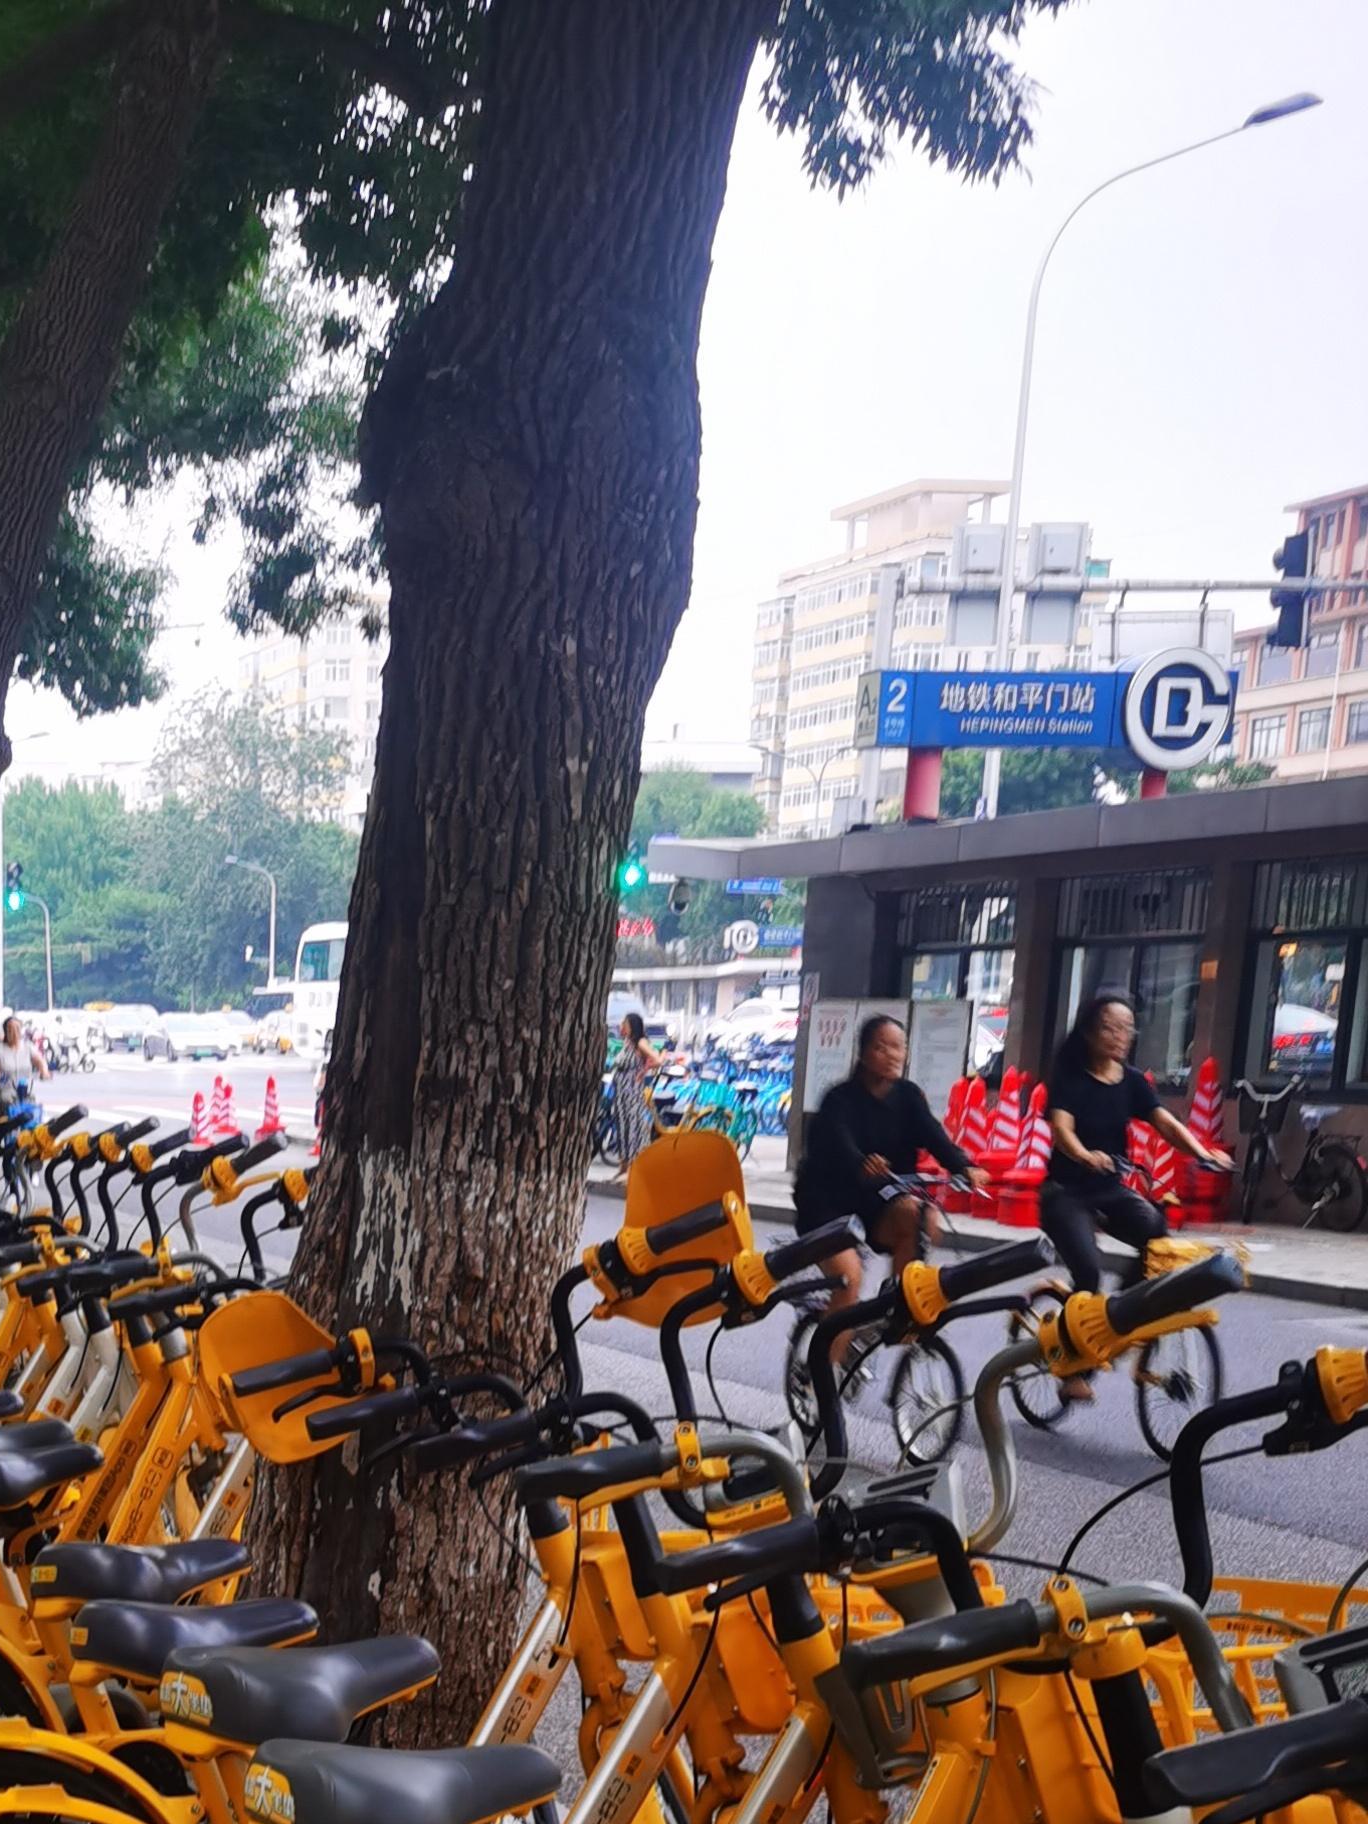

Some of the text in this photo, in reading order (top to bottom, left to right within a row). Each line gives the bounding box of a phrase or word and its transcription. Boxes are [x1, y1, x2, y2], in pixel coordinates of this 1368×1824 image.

[886, 678, 908, 713] 2
[939, 681, 1096, 715] 地铁和平门站
[960, 716, 1093, 735] HEPINGMEN Station
